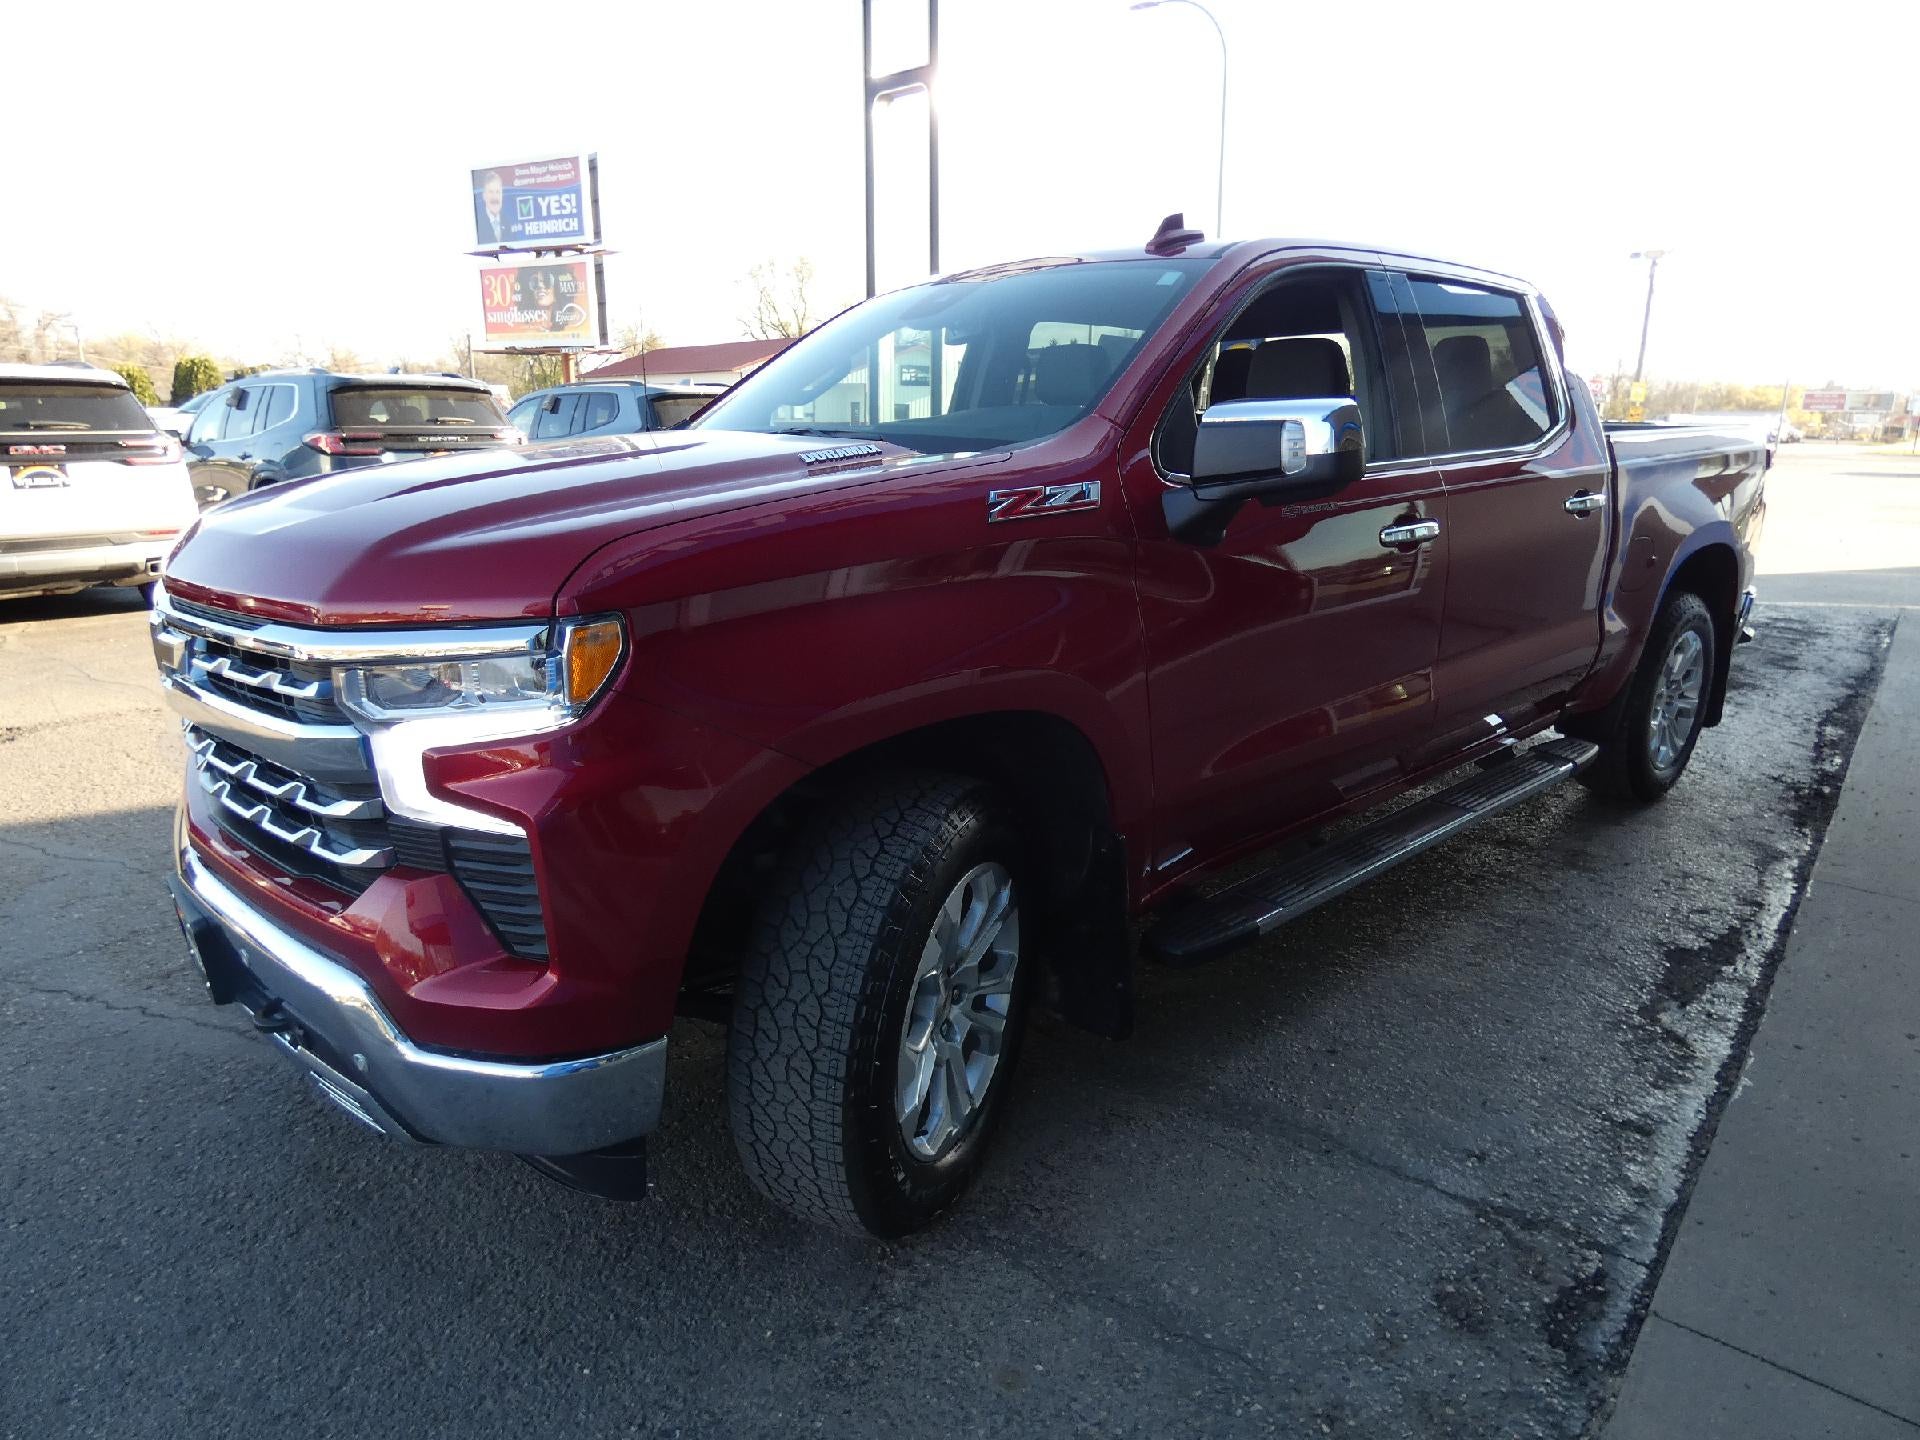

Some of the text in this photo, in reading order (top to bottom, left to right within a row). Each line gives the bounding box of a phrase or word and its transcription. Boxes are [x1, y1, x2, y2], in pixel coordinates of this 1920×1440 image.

[538, 193, 577, 216] YES!
[525, 218, 578, 235] HEINRICH
[486, 306, 548, 327] sunglasses
[9, 445, 67, 455] GMC
[798, 444, 882, 464] DURAMAX
[988, 480, 1101, 523] Z71
